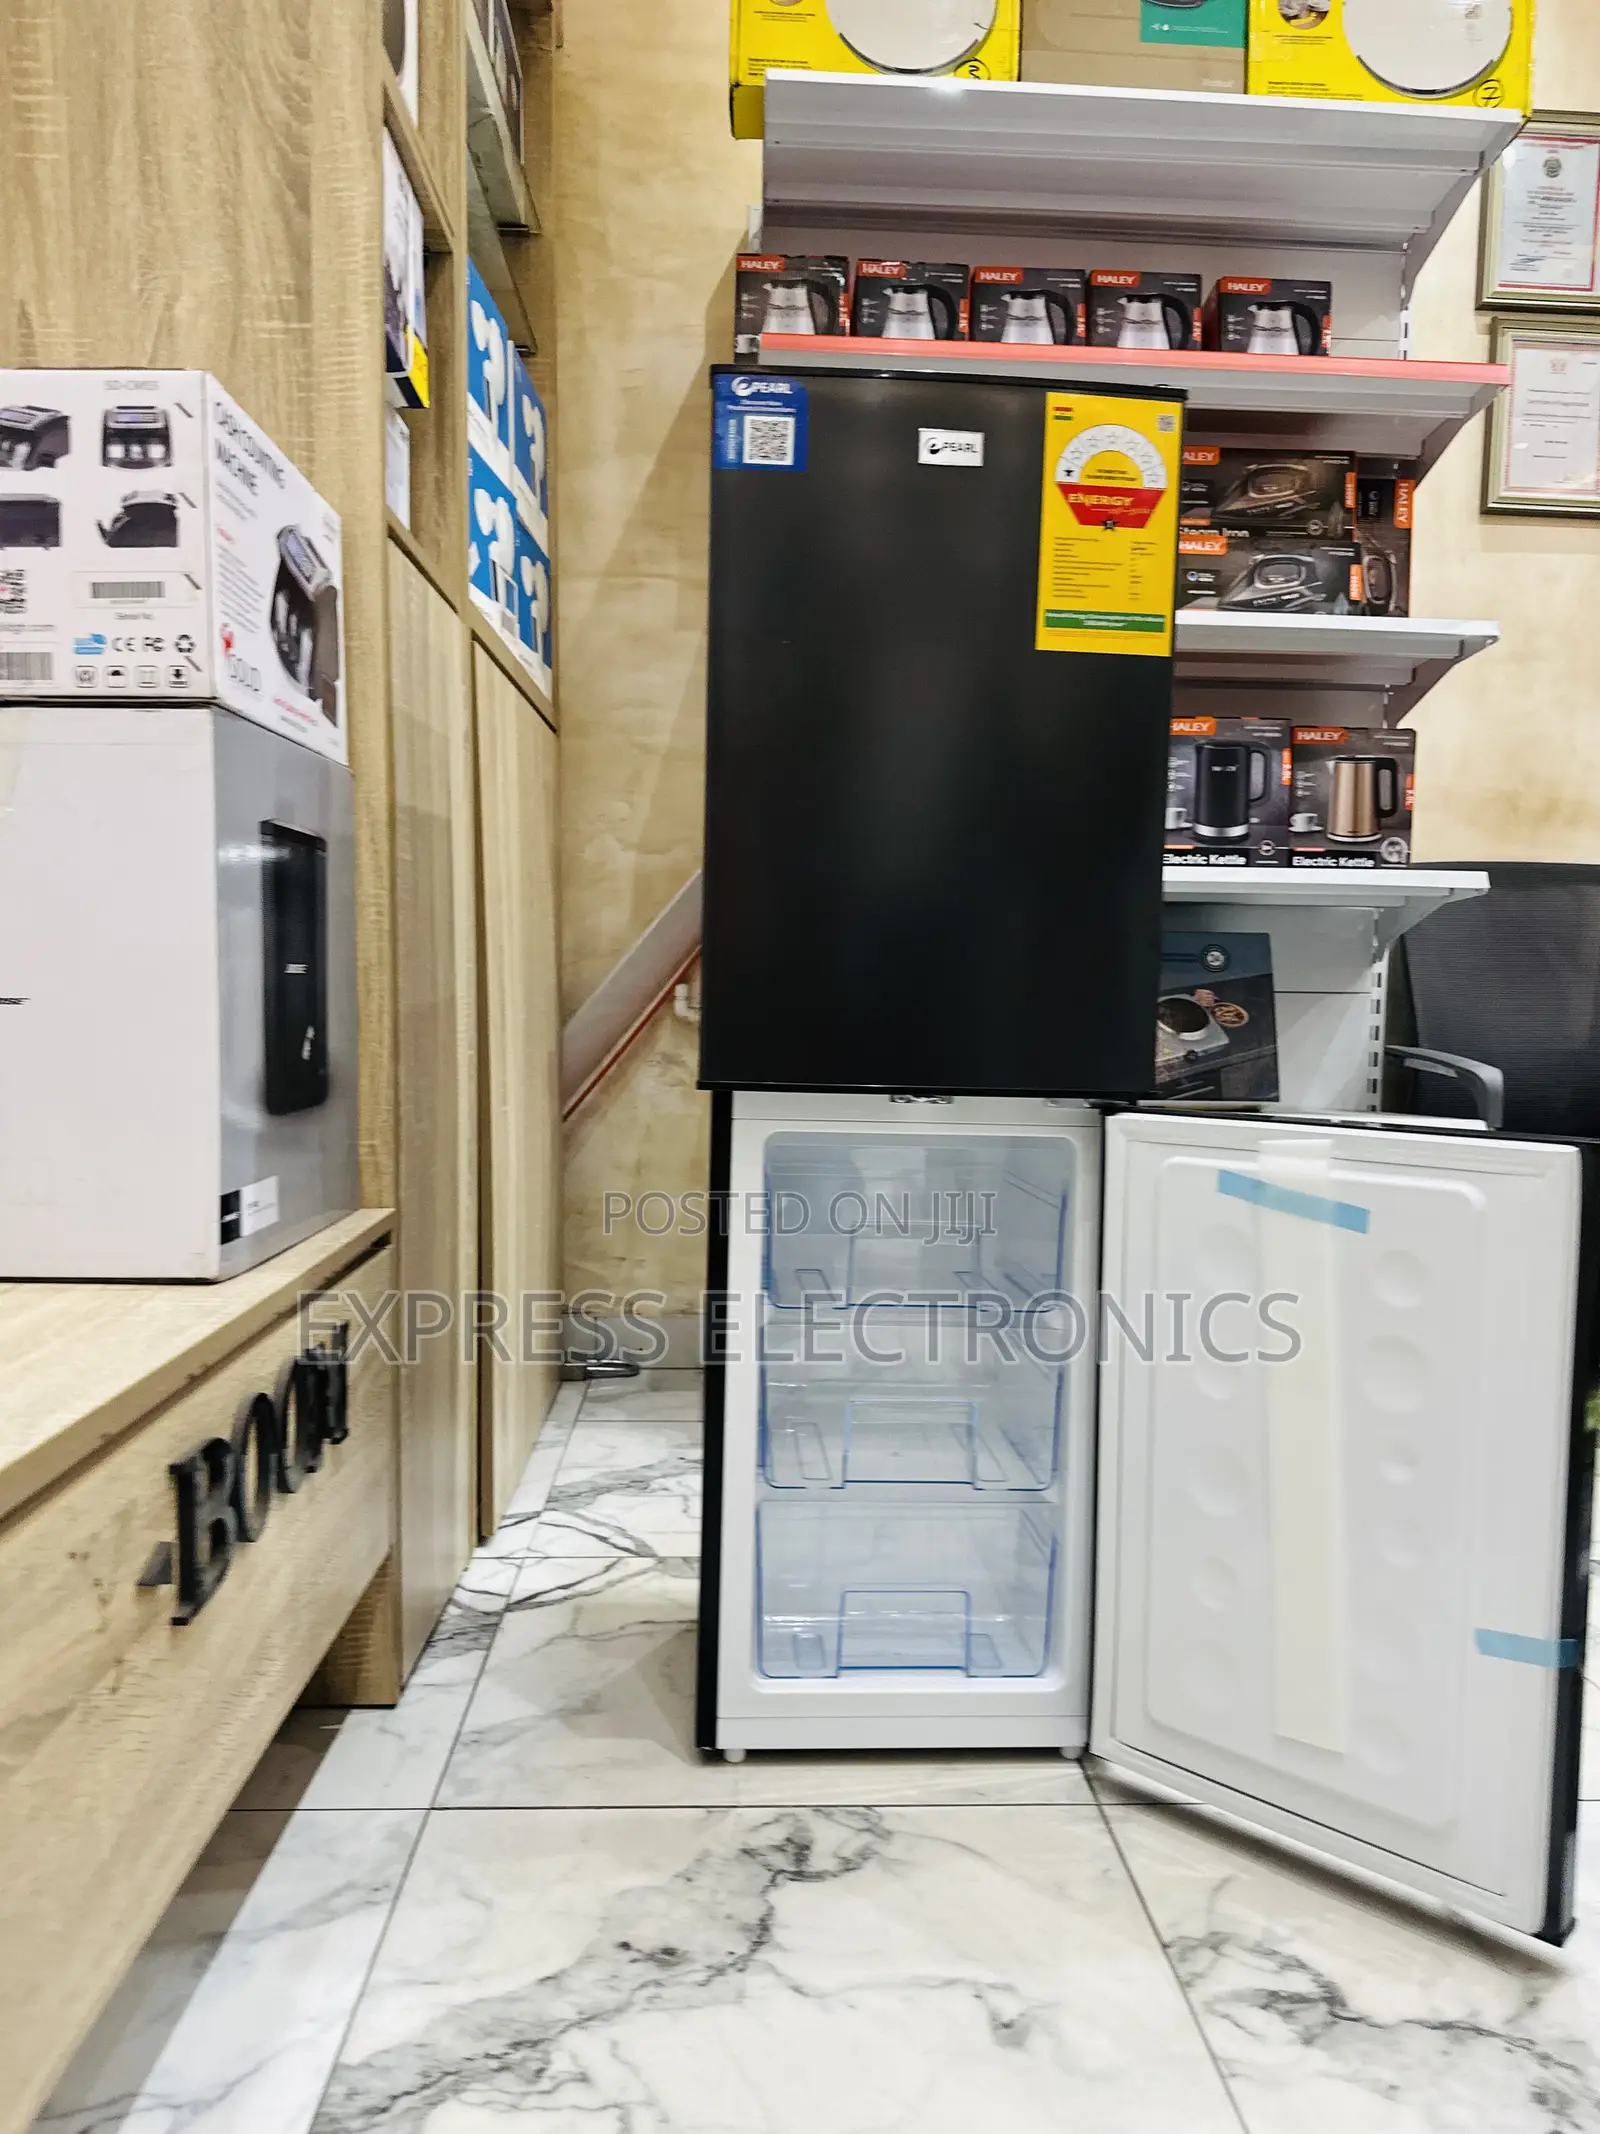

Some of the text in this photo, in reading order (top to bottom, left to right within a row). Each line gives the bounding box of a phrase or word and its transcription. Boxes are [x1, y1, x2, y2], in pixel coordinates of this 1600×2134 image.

[741, 260, 781, 270] HALEY
[862, 264, 900, 275] HALEY
[980, 272, 1018, 281] HALEY
[1097, 275, 1136, 285] HALEY
[1227, 282, 1266, 292] HALEY
[942, 442, 979, 453] PEARL
[1182, 452, 1215, 461] ALEY
[1398, 482, 1409, 523] HALEY
[1171, 722, 1211, 732] HALEY
[1297, 731, 1343, 741] HALEY
[1163, 854, 1247, 865] Electric Kettle
[1292, 856, 1375, 867] Electric Kettle
